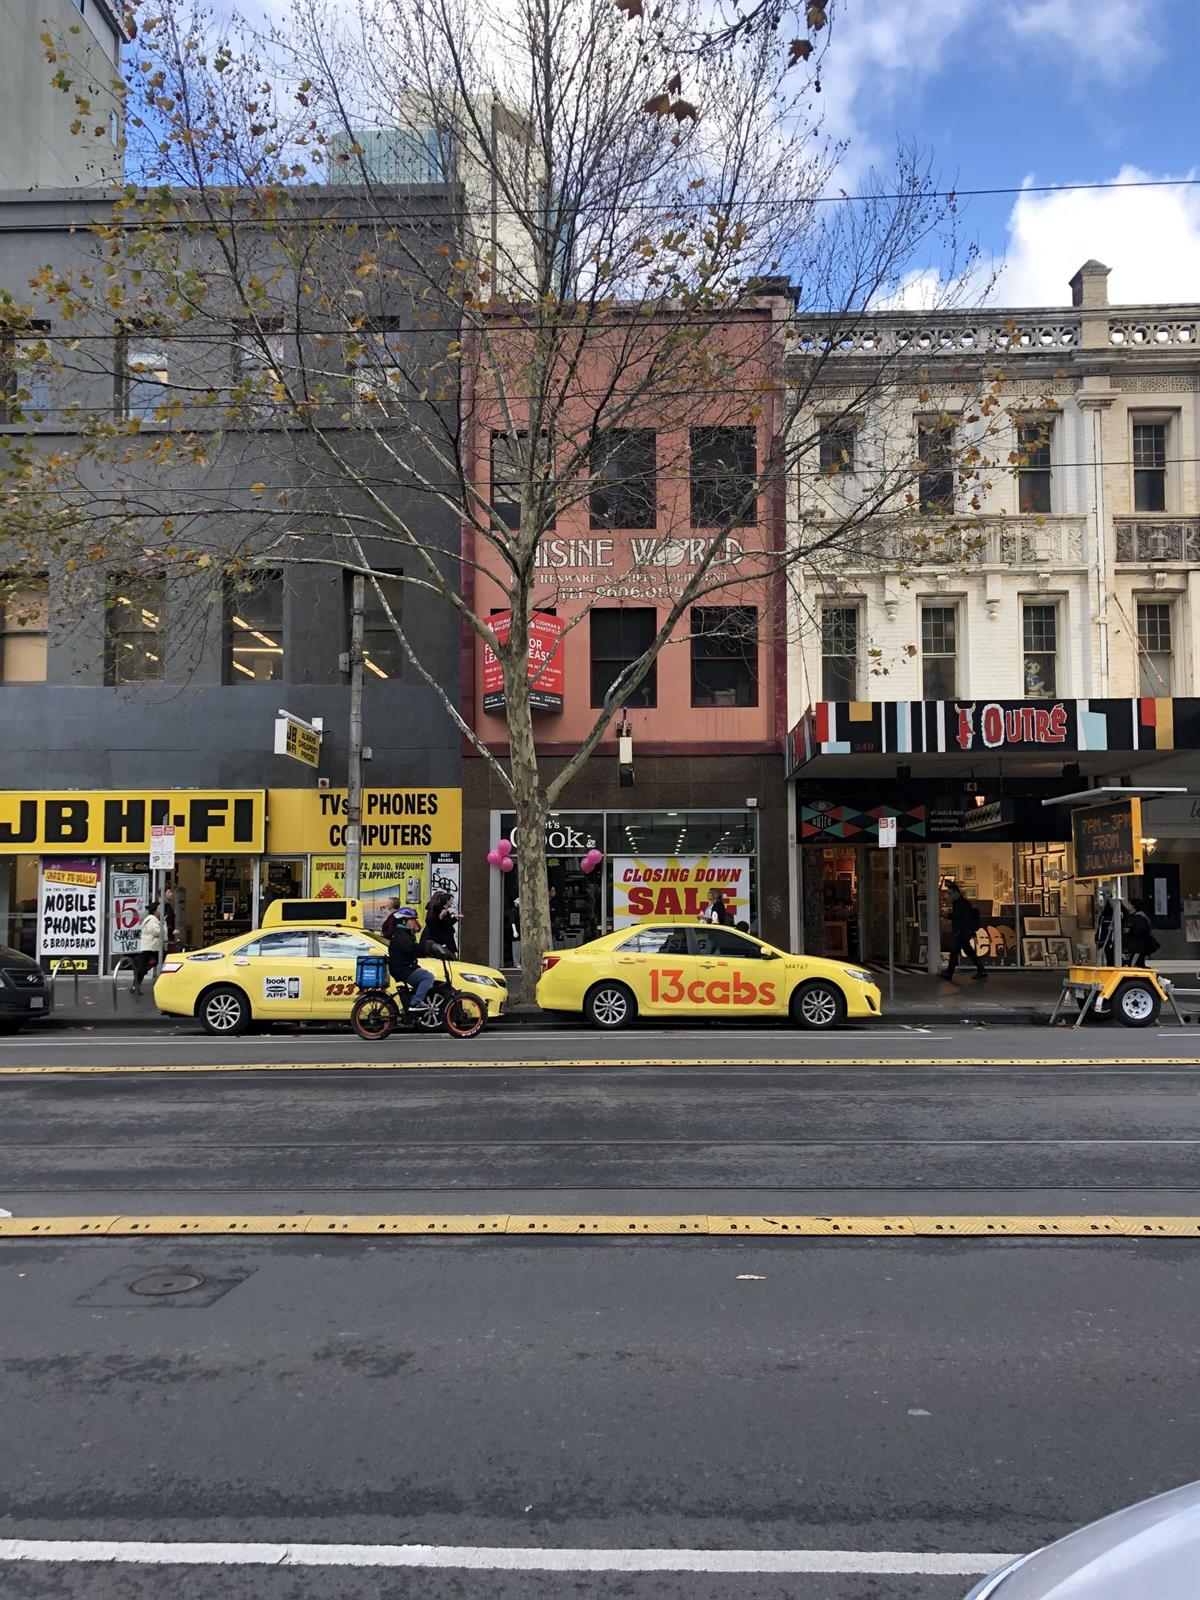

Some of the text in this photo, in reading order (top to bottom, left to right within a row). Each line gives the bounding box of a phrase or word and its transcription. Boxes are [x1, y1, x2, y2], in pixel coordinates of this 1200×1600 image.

[505, 538, 614, 567] ISINE
[510, 574, 598, 584] CHENWARE
[621, 573, 657, 583] HEFS
[662, 572, 729, 583] EQUIPENT
[528, 638, 543, 650] OR
[528, 648, 552, 663] EAS
[367, 793, 438, 816] PHONES
[0, 799, 254, 843] JB HI-FI
[544, 820, 560, 829] et's
[1092, 833, 1120, 851] FROM
[394, 862, 424, 871] VACUUMS
[334, 871, 340, 880] &
[368, 871, 406, 880] APPLIANCES
[622, 868, 742, 883] CLOSING DOWN
[44, 894, 96, 916] MOBILE
[628, 887, 737, 916] SALE
[44, 914, 96, 936] PHONES
[43, 937, 96, 950] & BROADBAND
[265, 977, 286, 985] book
[648, 969, 776, 1006] 13cabs
